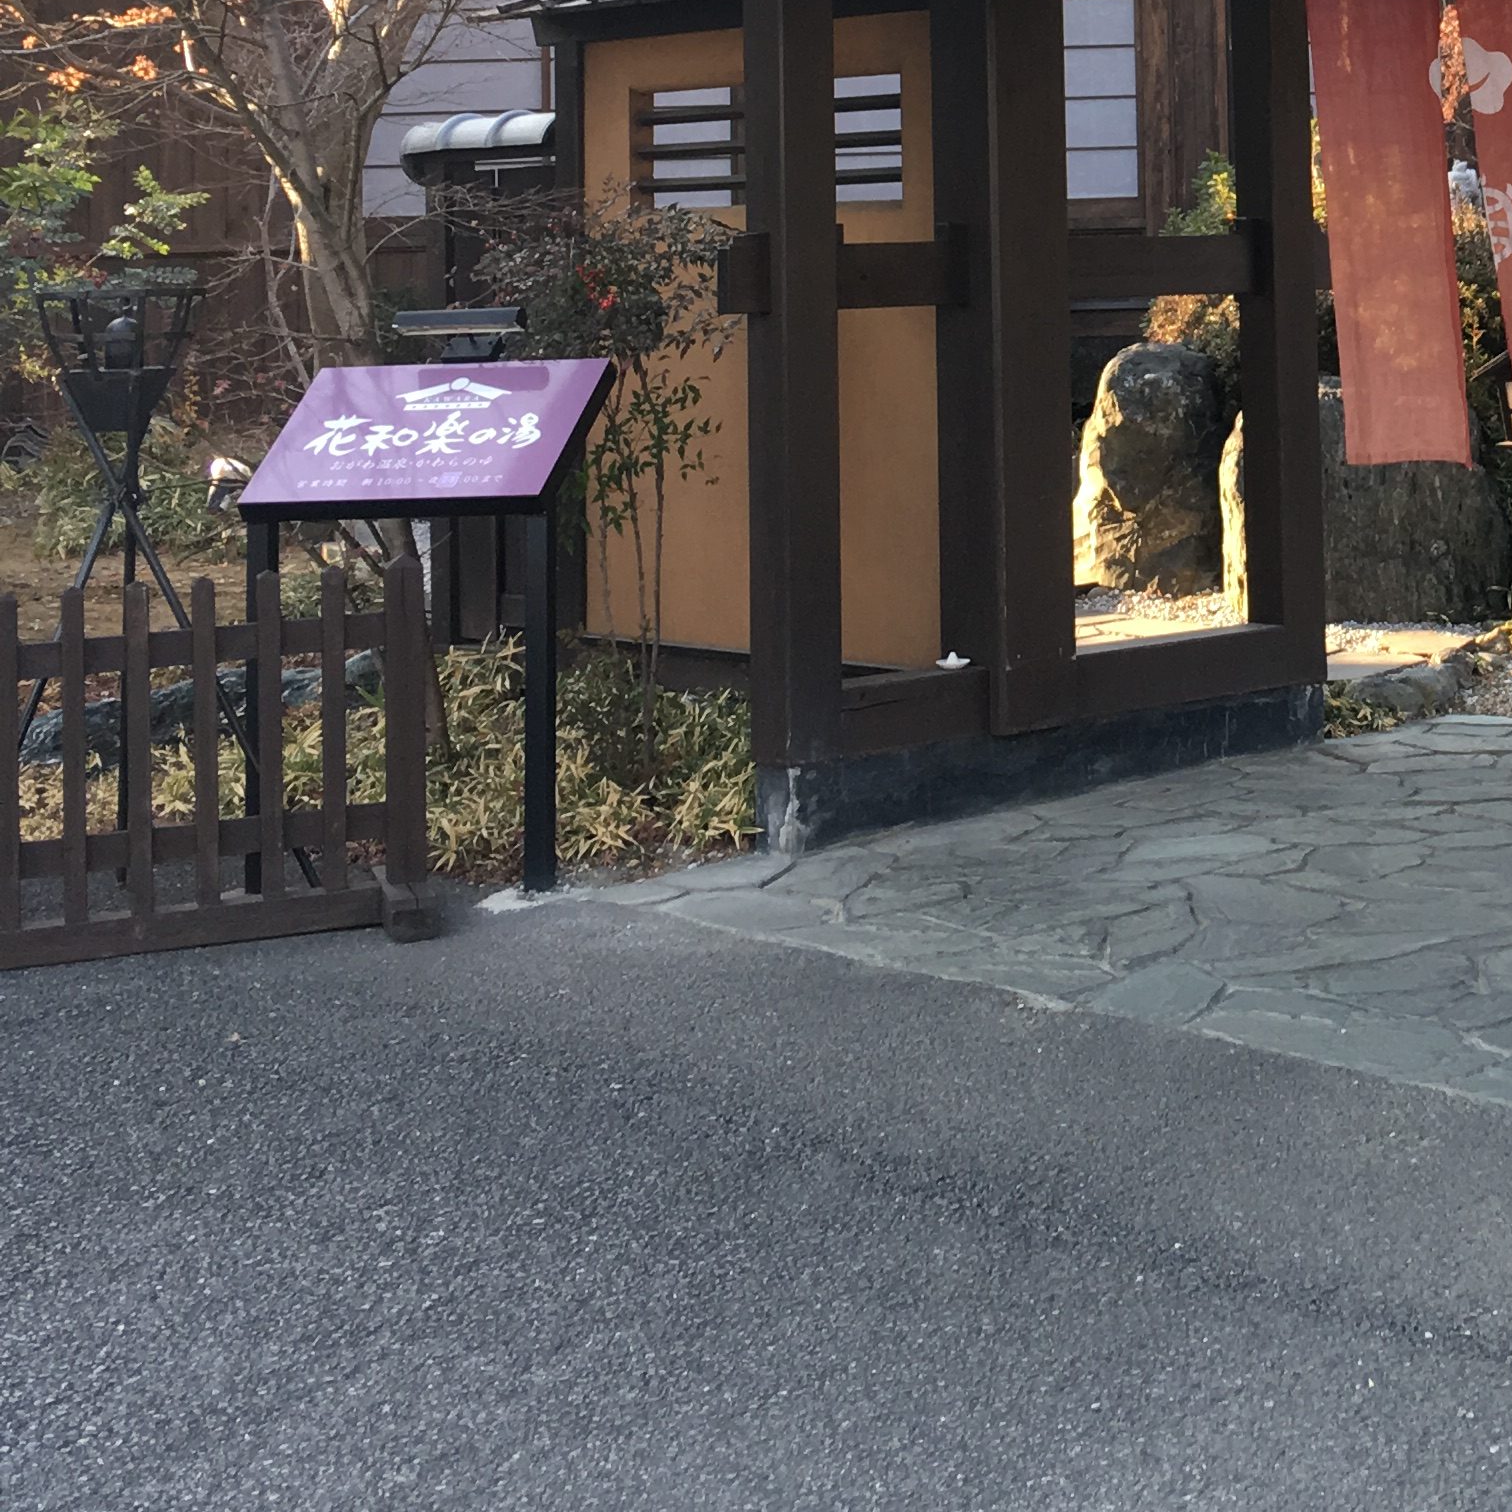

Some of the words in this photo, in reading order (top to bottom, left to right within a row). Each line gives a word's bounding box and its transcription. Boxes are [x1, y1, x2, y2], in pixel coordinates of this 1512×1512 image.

[303, 410, 541, 456] 花和楽の湯
